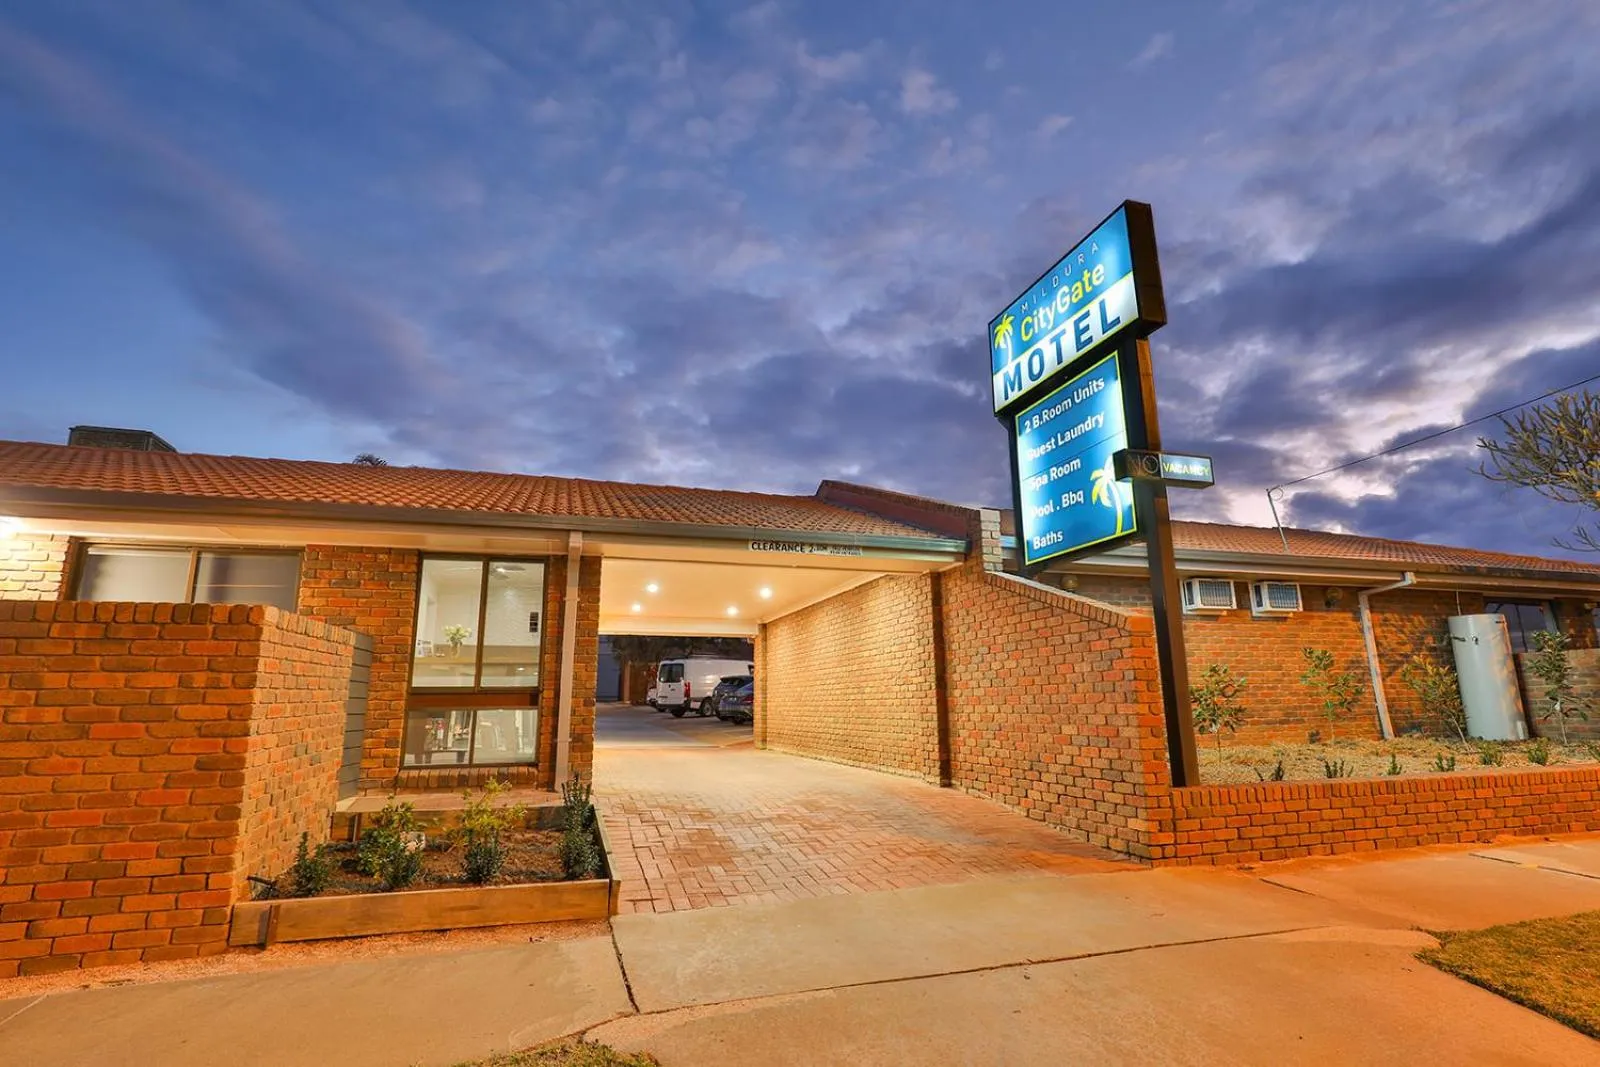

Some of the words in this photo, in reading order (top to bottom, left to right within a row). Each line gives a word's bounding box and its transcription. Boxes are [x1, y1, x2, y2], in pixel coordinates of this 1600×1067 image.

[1021, 242, 1099, 314] MILDURA
[1020, 262, 1105, 342] CityGate
[1003, 298, 1121, 401] MOTEL
[1024, 420, 1031, 434] 2
[1073, 377, 1105, 403] Units
[1057, 411, 1105, 446] Laundry
[1049, 458, 1081, 481] Room
[1061, 490, 1084, 508] Bbq
[751, 541, 804, 553] CLEARANCE
[1033, 530, 1063, 550] Baths
